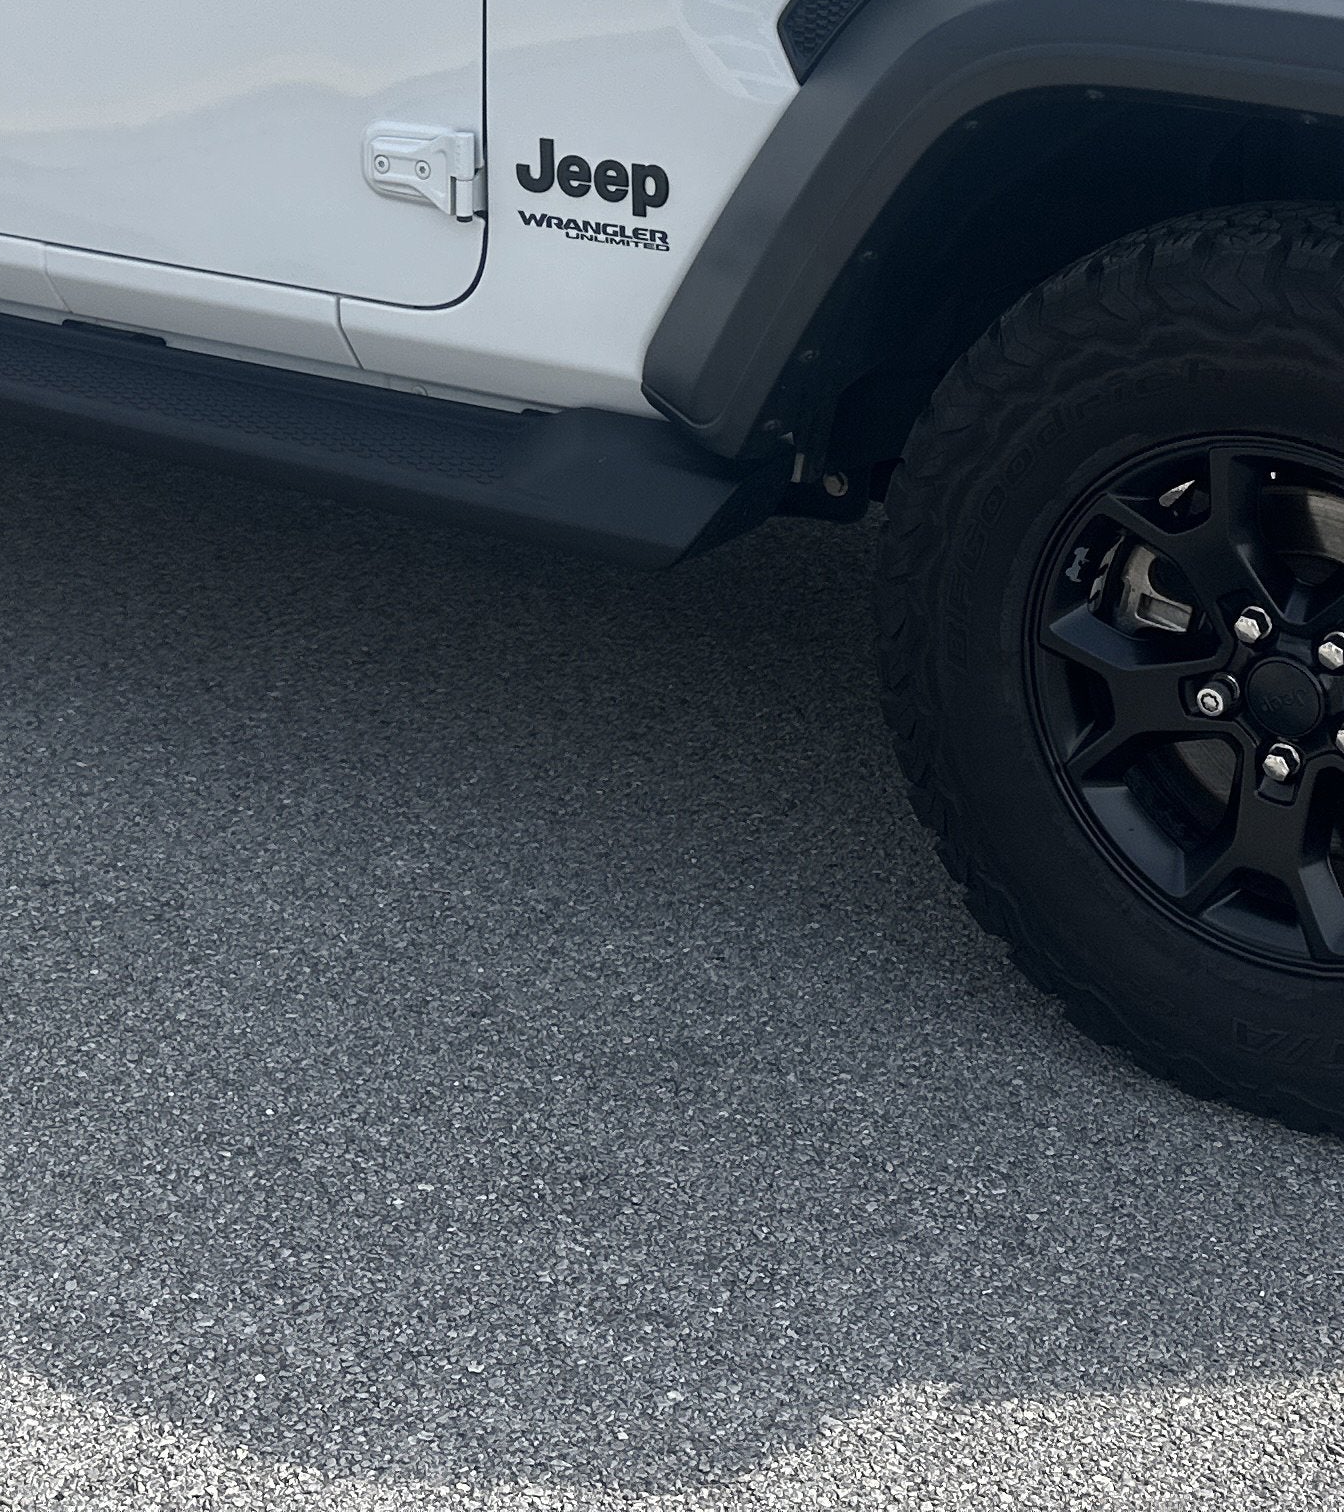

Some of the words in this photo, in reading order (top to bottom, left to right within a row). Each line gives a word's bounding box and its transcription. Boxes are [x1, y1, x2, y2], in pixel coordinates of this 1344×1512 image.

[515, 137, 670, 218] Jeep
[517, 210, 670, 245] WRANGLER
[564, 231, 670, 252] UNLIMITED
